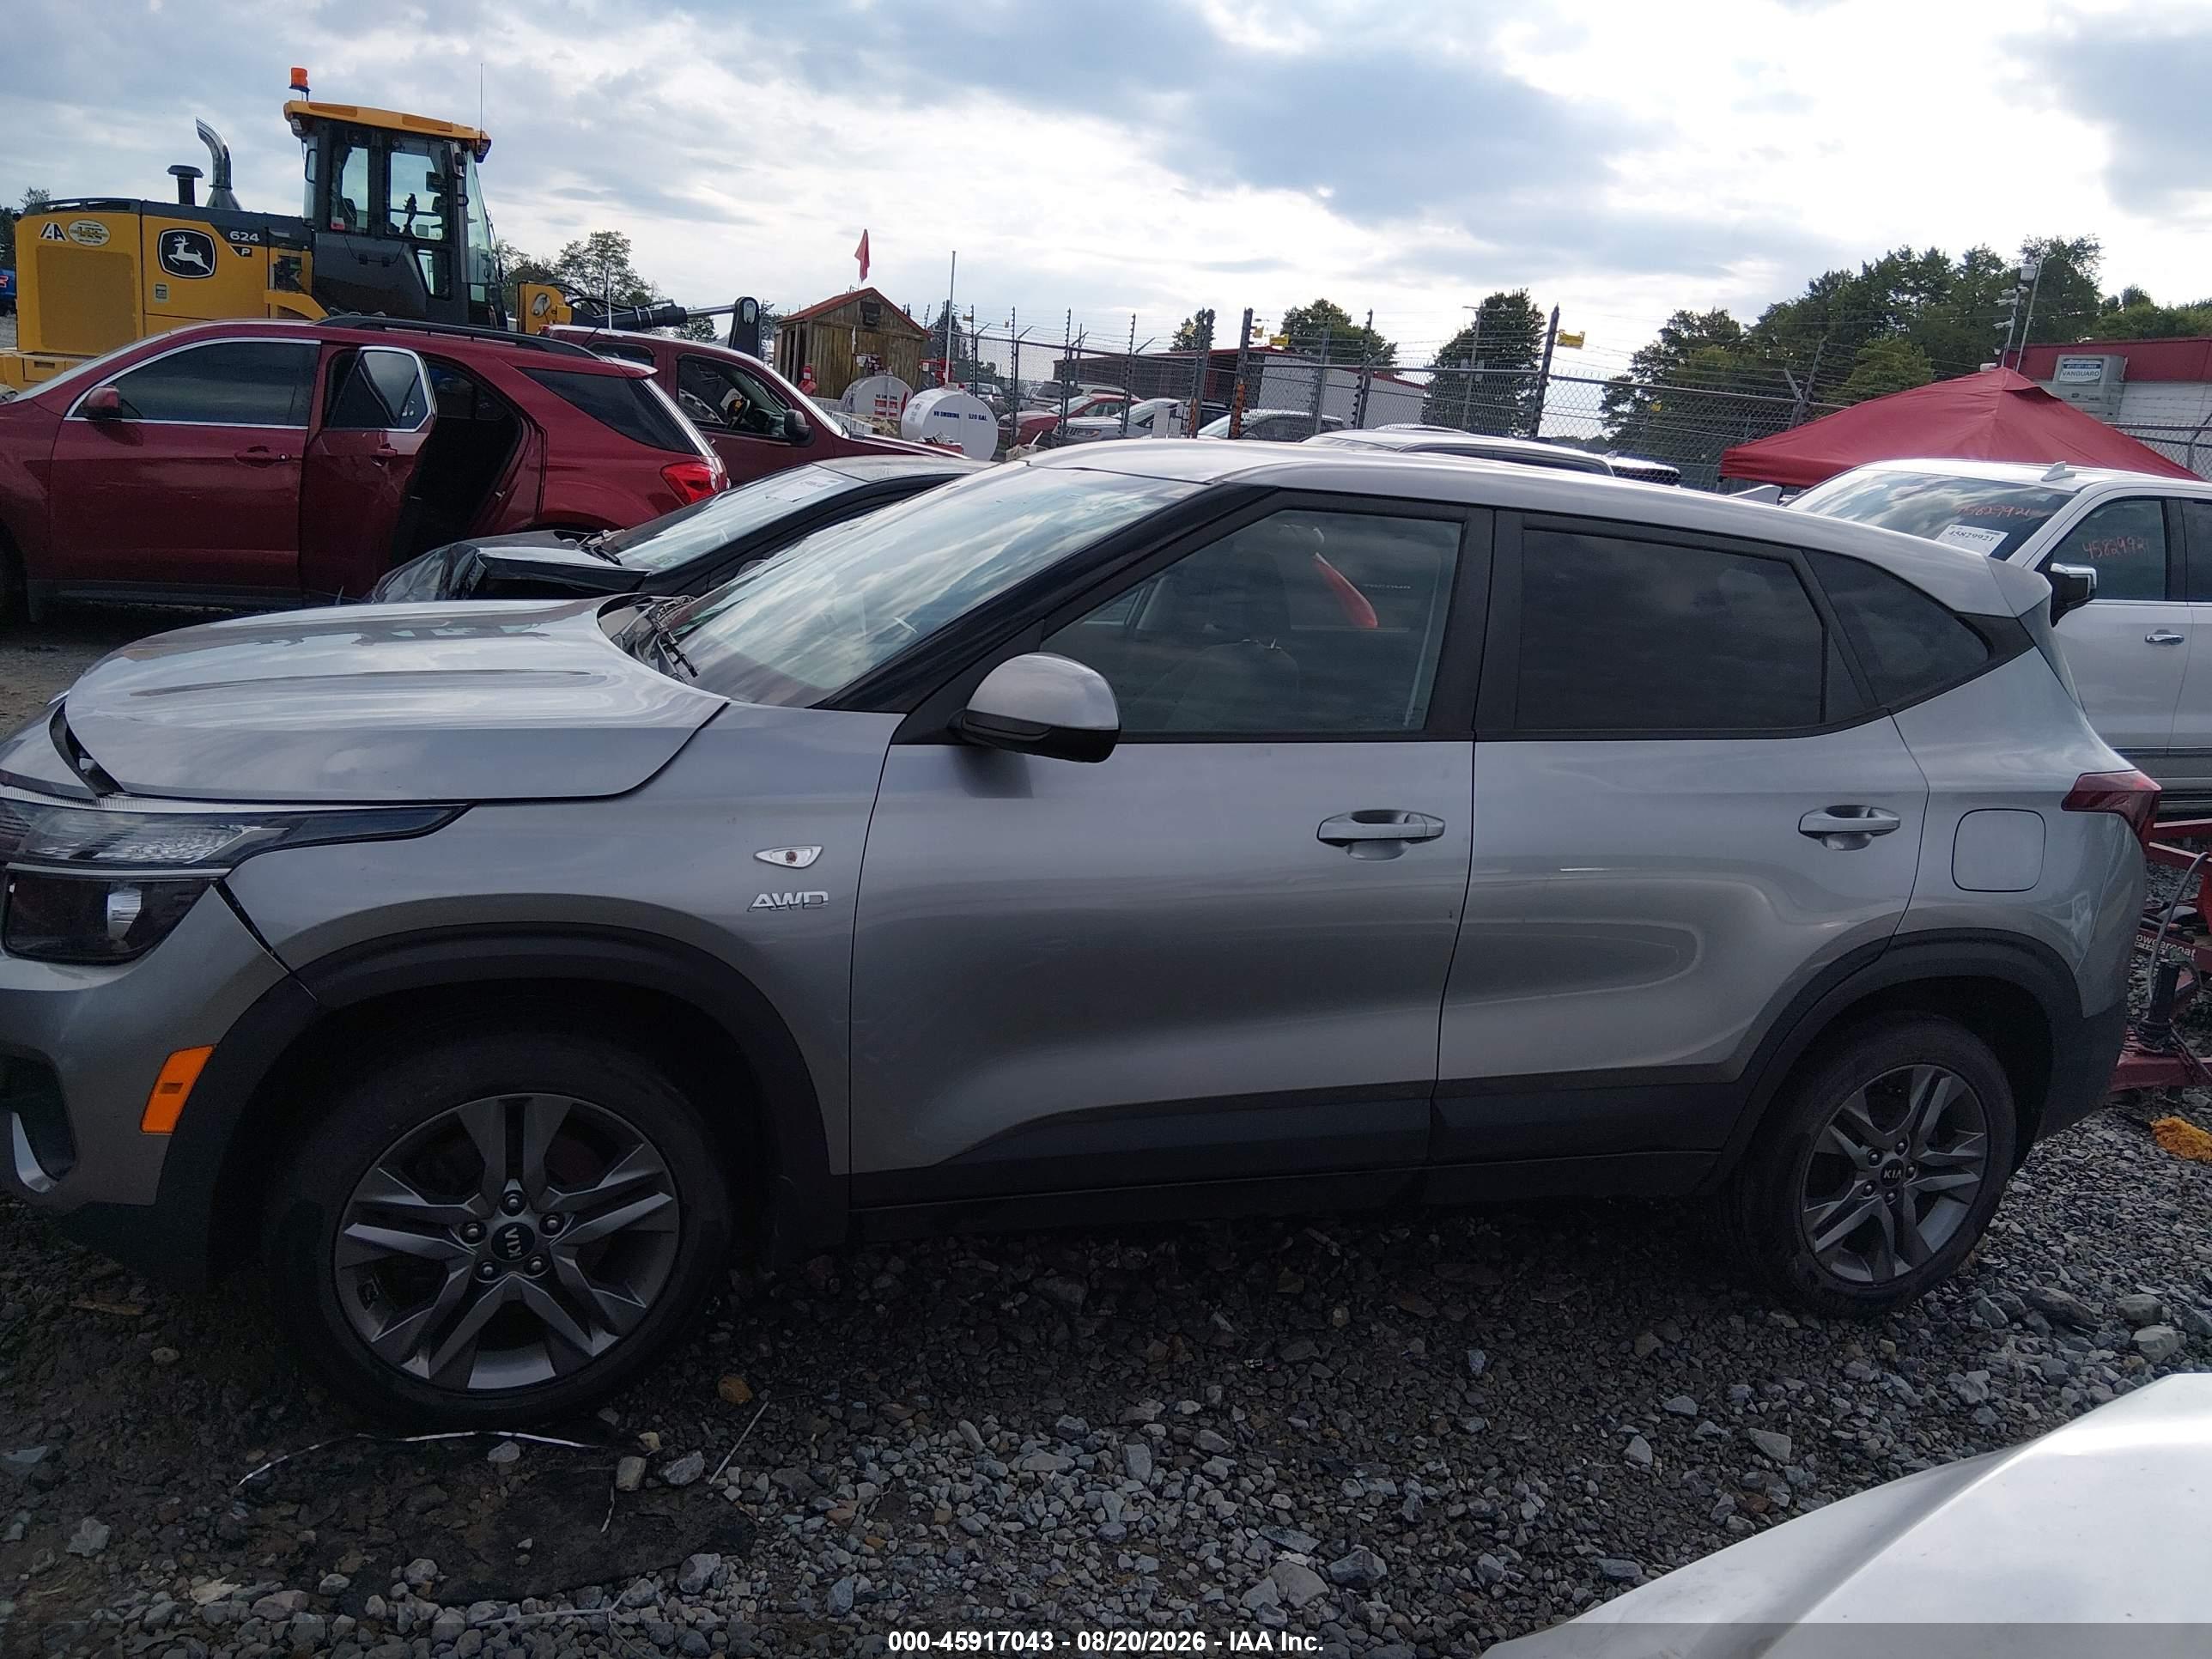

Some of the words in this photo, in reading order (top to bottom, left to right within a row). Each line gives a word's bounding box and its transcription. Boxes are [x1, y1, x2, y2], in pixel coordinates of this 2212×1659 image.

[229, 230, 260, 242] 624
[240, 247, 251, 257] P
[748, 890, 829, 910] AWD
[2136, 934, 2196, 958] owercoat
[1883, 1170, 1901, 1179] KIA
[505, 1227, 522, 1258] KIA
